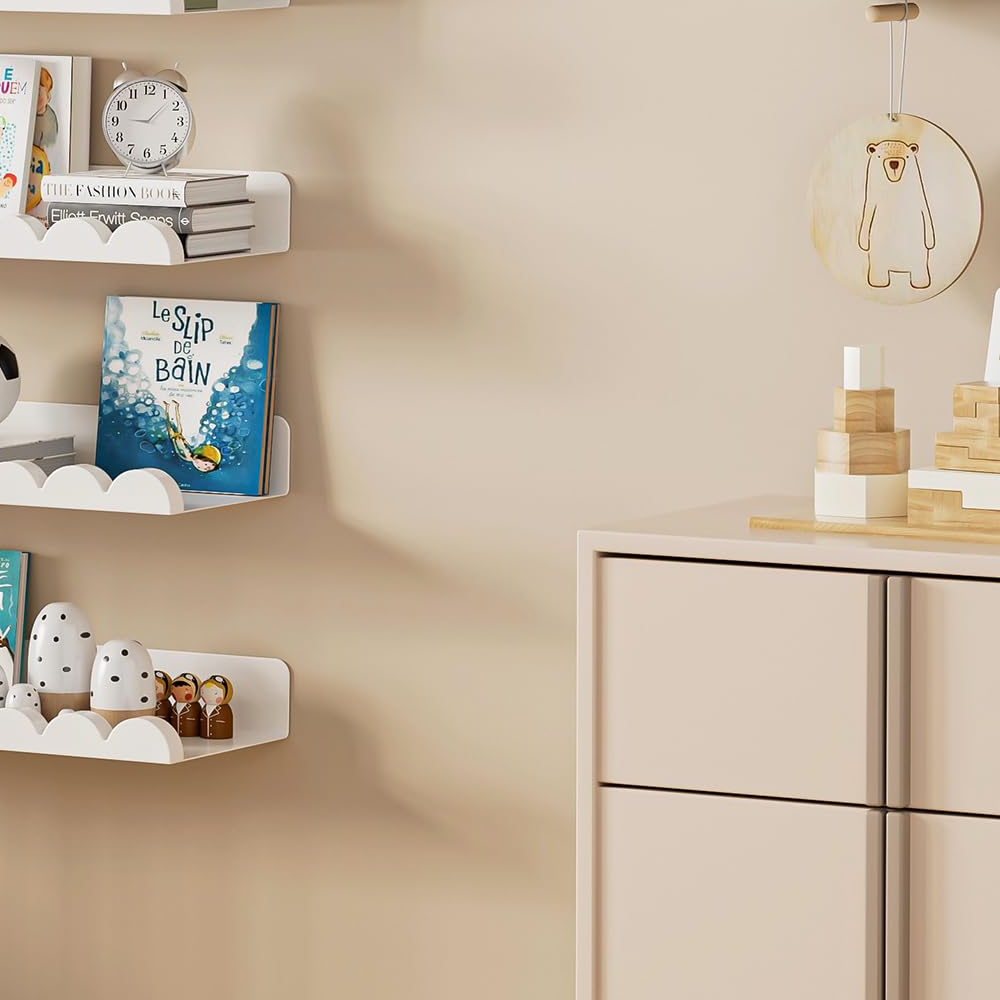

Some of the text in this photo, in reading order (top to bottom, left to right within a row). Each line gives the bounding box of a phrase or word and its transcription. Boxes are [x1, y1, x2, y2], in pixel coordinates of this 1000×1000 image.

[129, 88, 138, 99] 11
[143, 85, 156, 96] 12
[163, 89, 167, 100] 1
[116, 100, 128, 111] 10
[172, 101, 180, 111] 2
[111, 116, 119, 126] 9
[176, 116, 184, 127] 3
[115, 132, 123, 142] 8
[171, 132, 178, 143] 4
[127, 144, 135, 154] 7
[143, 148, 151, 158] 6
[160, 145, 167, 155] 5
[45, 183, 73, 197] THE
[76, 185, 137, 198] FASHION
[141, 187, 180, 201] BOOK
[153, 300, 171, 322] Le
